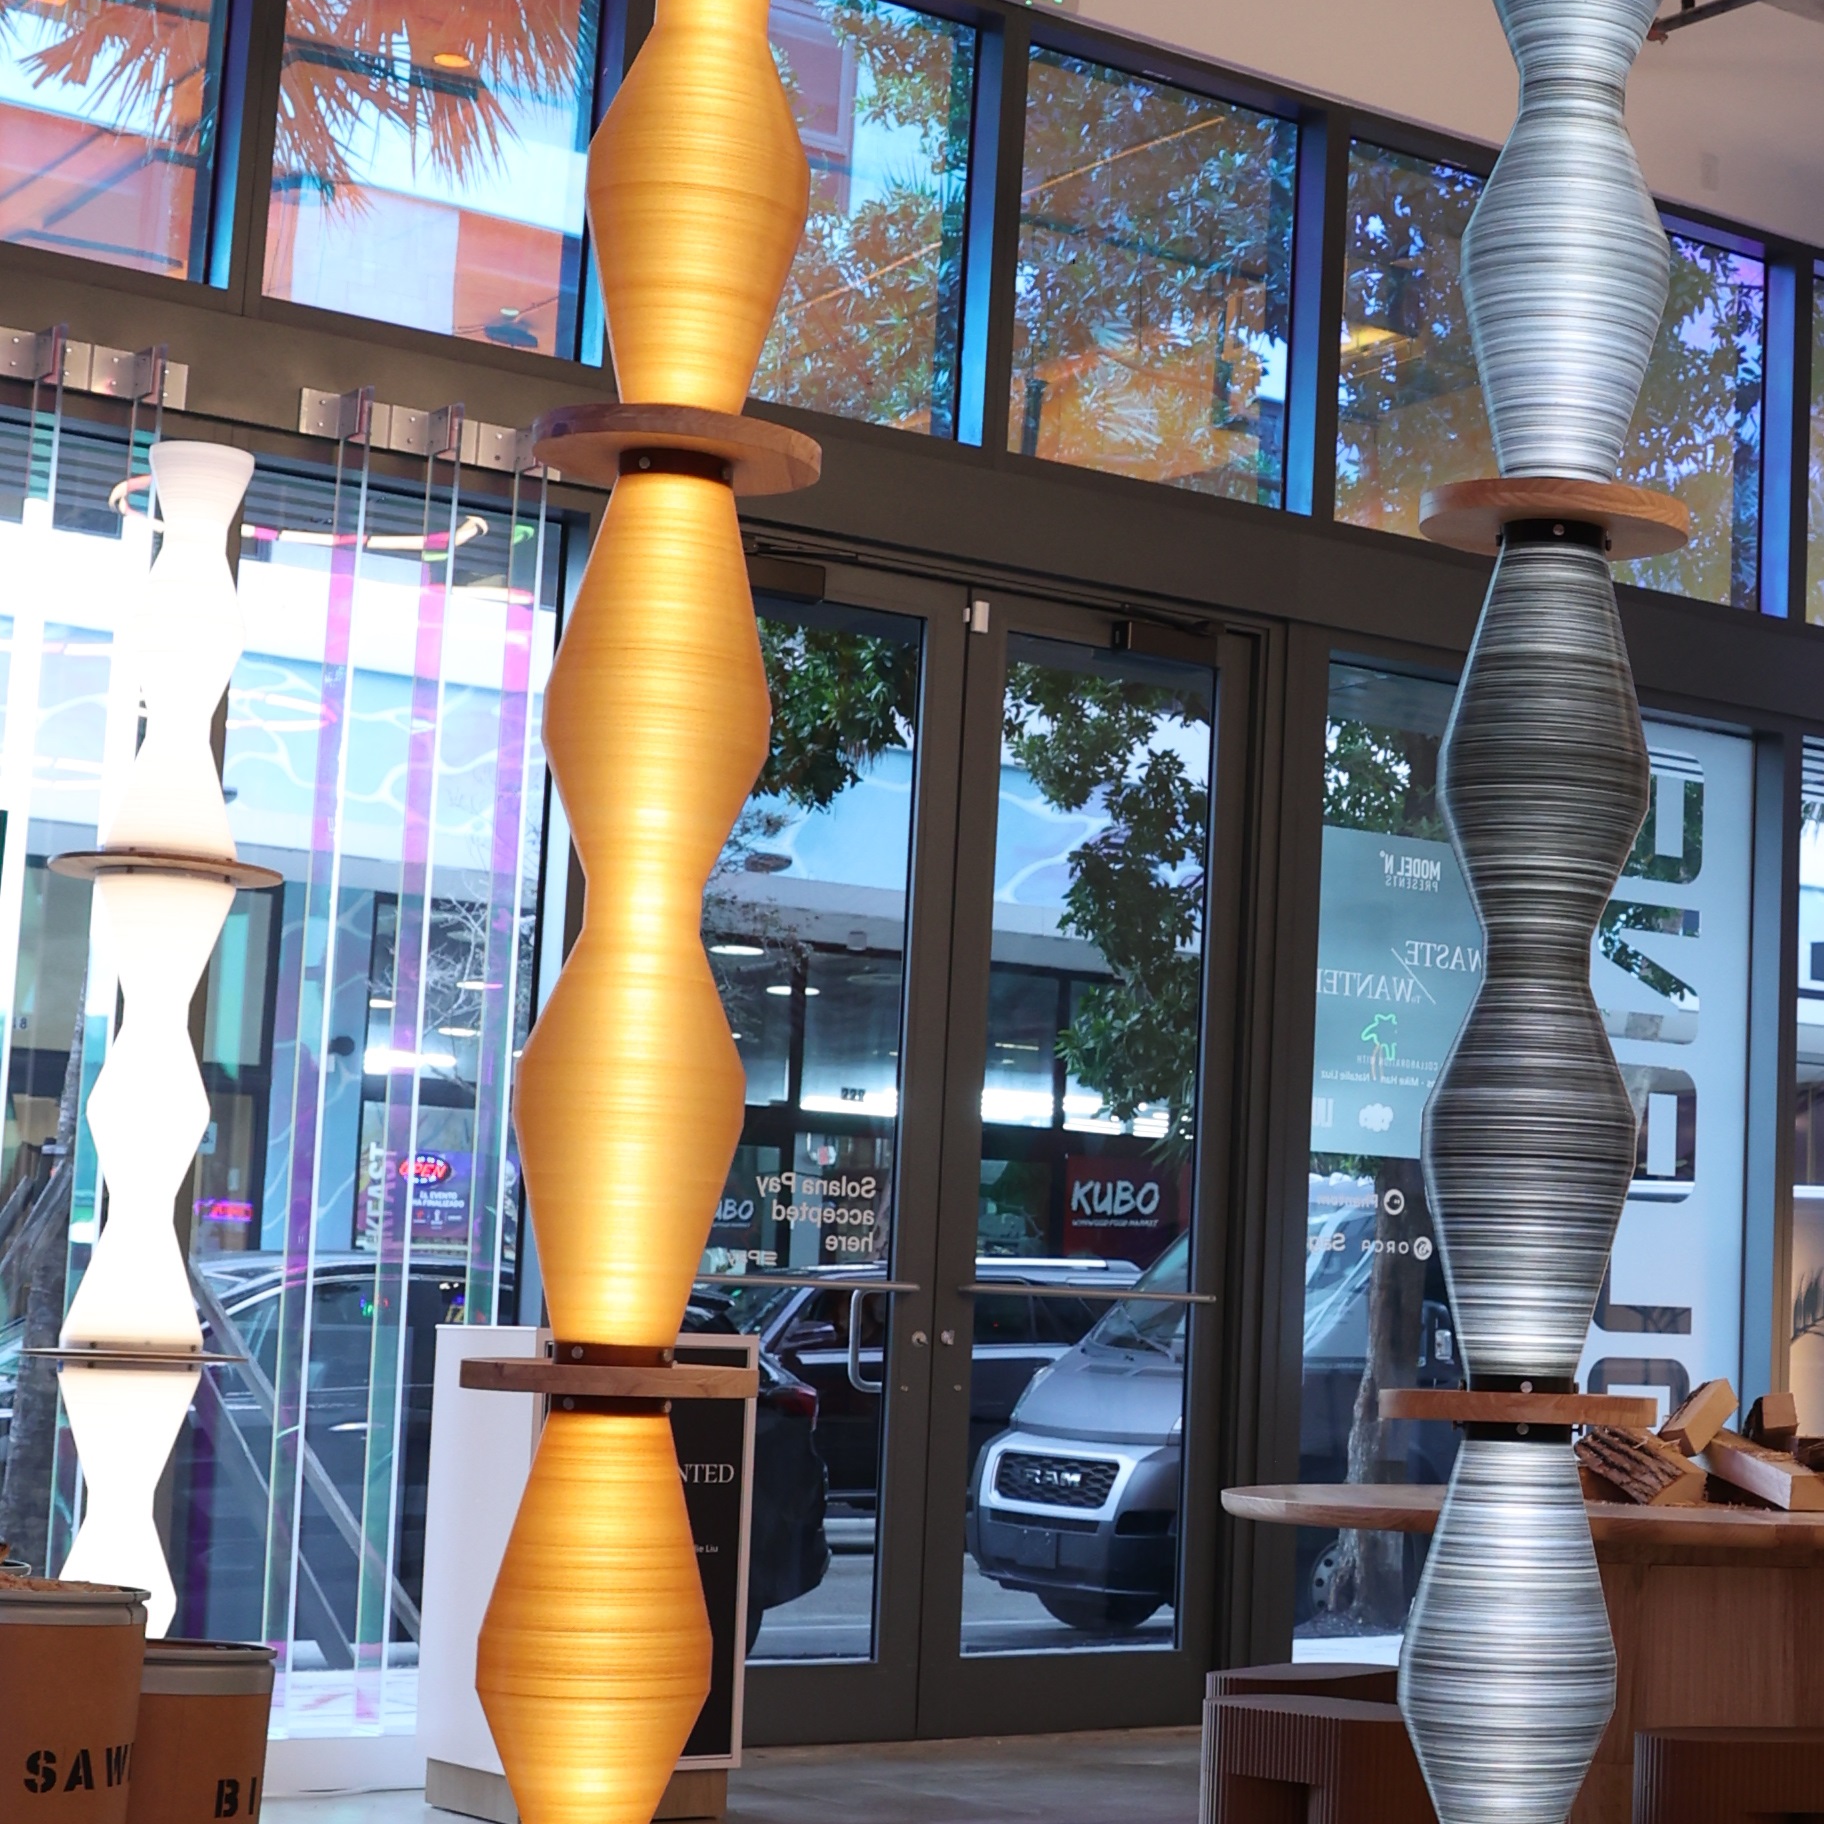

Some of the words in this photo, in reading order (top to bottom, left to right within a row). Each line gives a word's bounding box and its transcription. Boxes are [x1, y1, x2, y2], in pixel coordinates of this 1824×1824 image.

[399, 1161, 448, 1179] OPEN
[1071, 1180, 1160, 1216] KUBO
[1024, 1468, 1081, 1487] RAM
[23, 1743, 134, 1793] SAW
